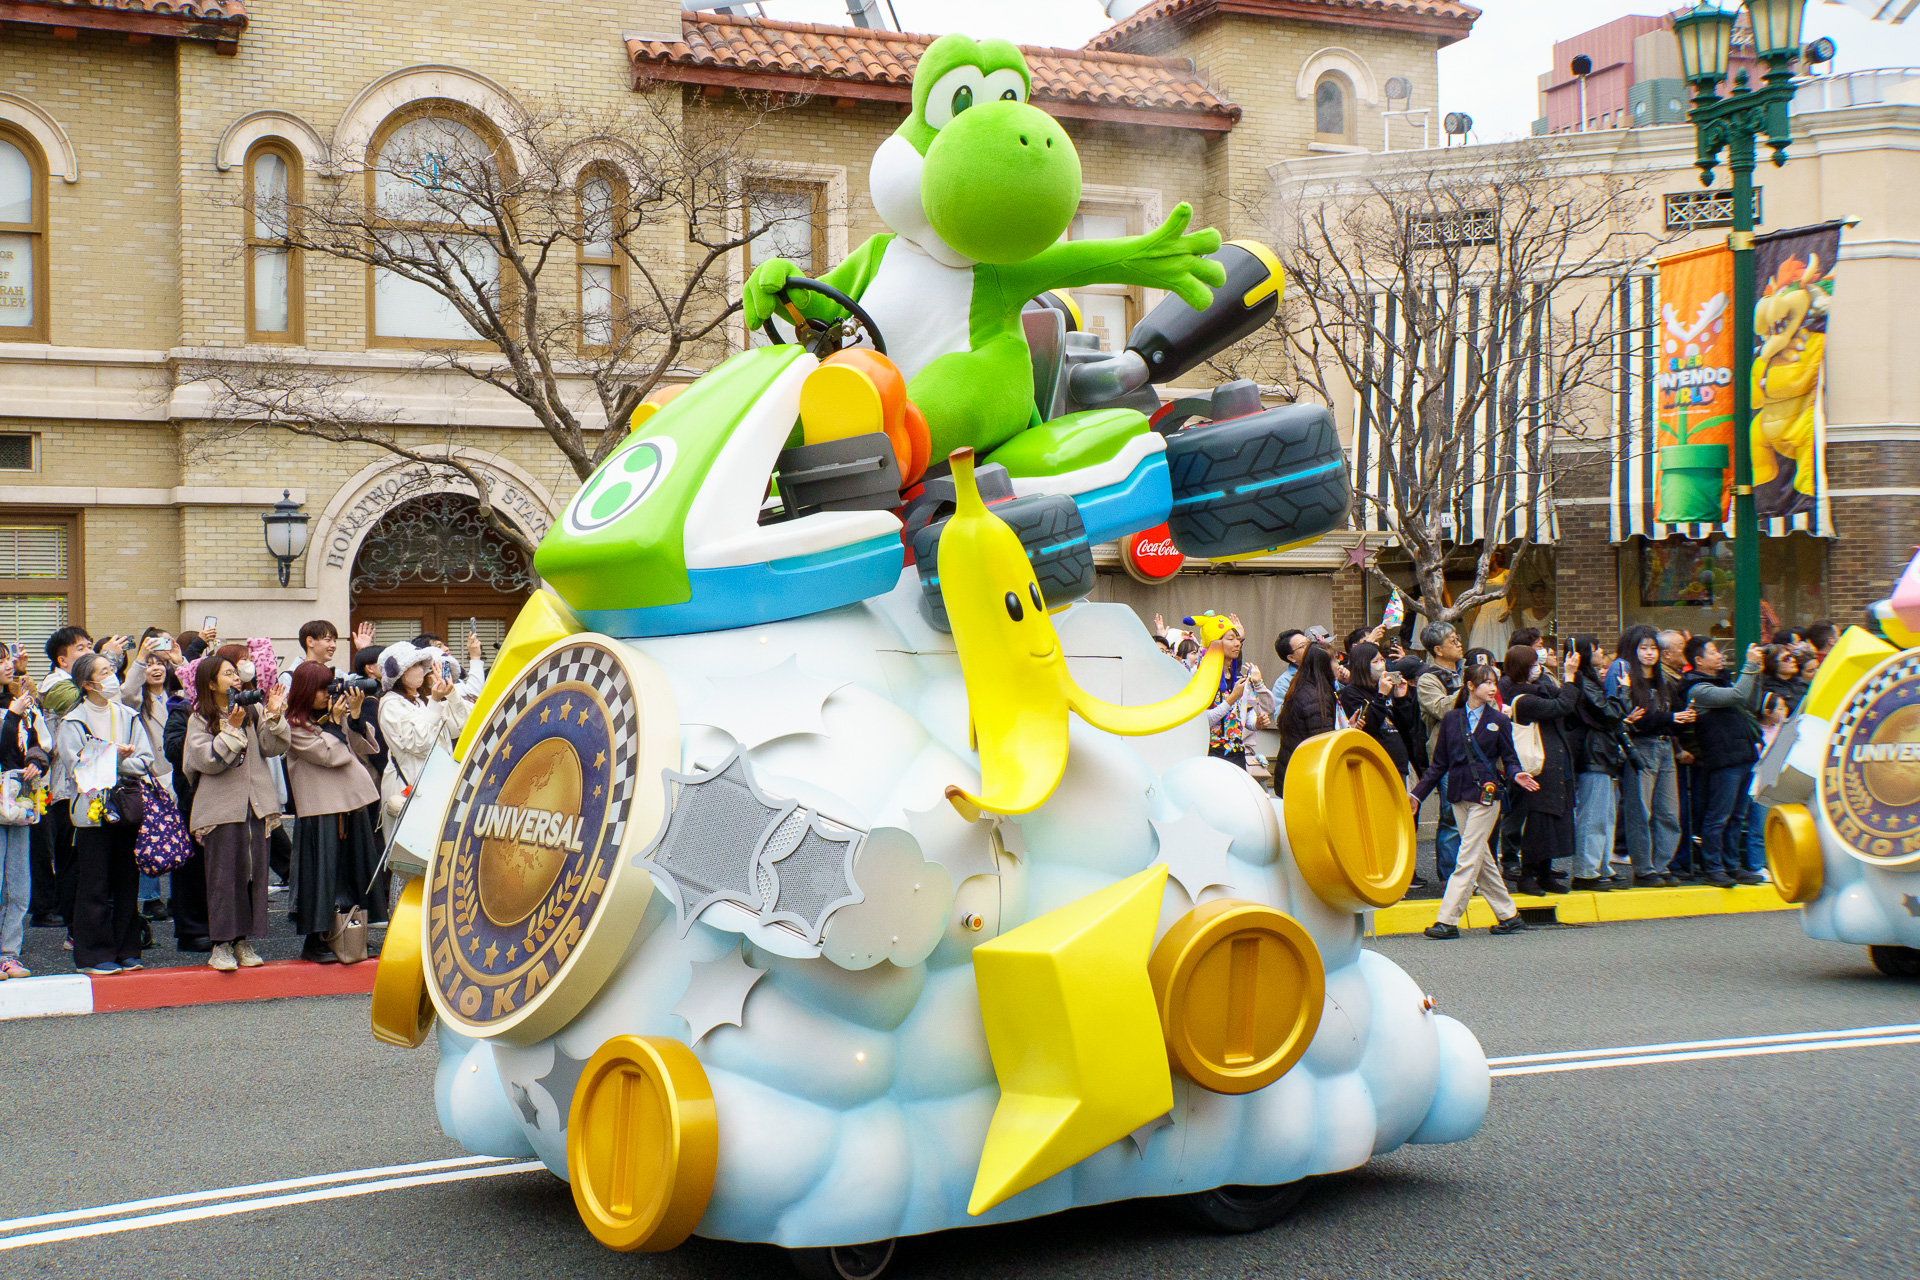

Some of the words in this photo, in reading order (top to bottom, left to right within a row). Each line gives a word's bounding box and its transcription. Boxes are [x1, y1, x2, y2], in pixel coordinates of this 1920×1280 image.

[1669, 355, 1703, 370] SUER
[1136, 538, 1180, 557] Coca-Cola
[473, 803, 585, 853] UNIVERSAL
[1824, 767, 1894, 856] MARIO
[431, 840, 482, 1017] MARIO
[491, 857, 607, 1018] KART
